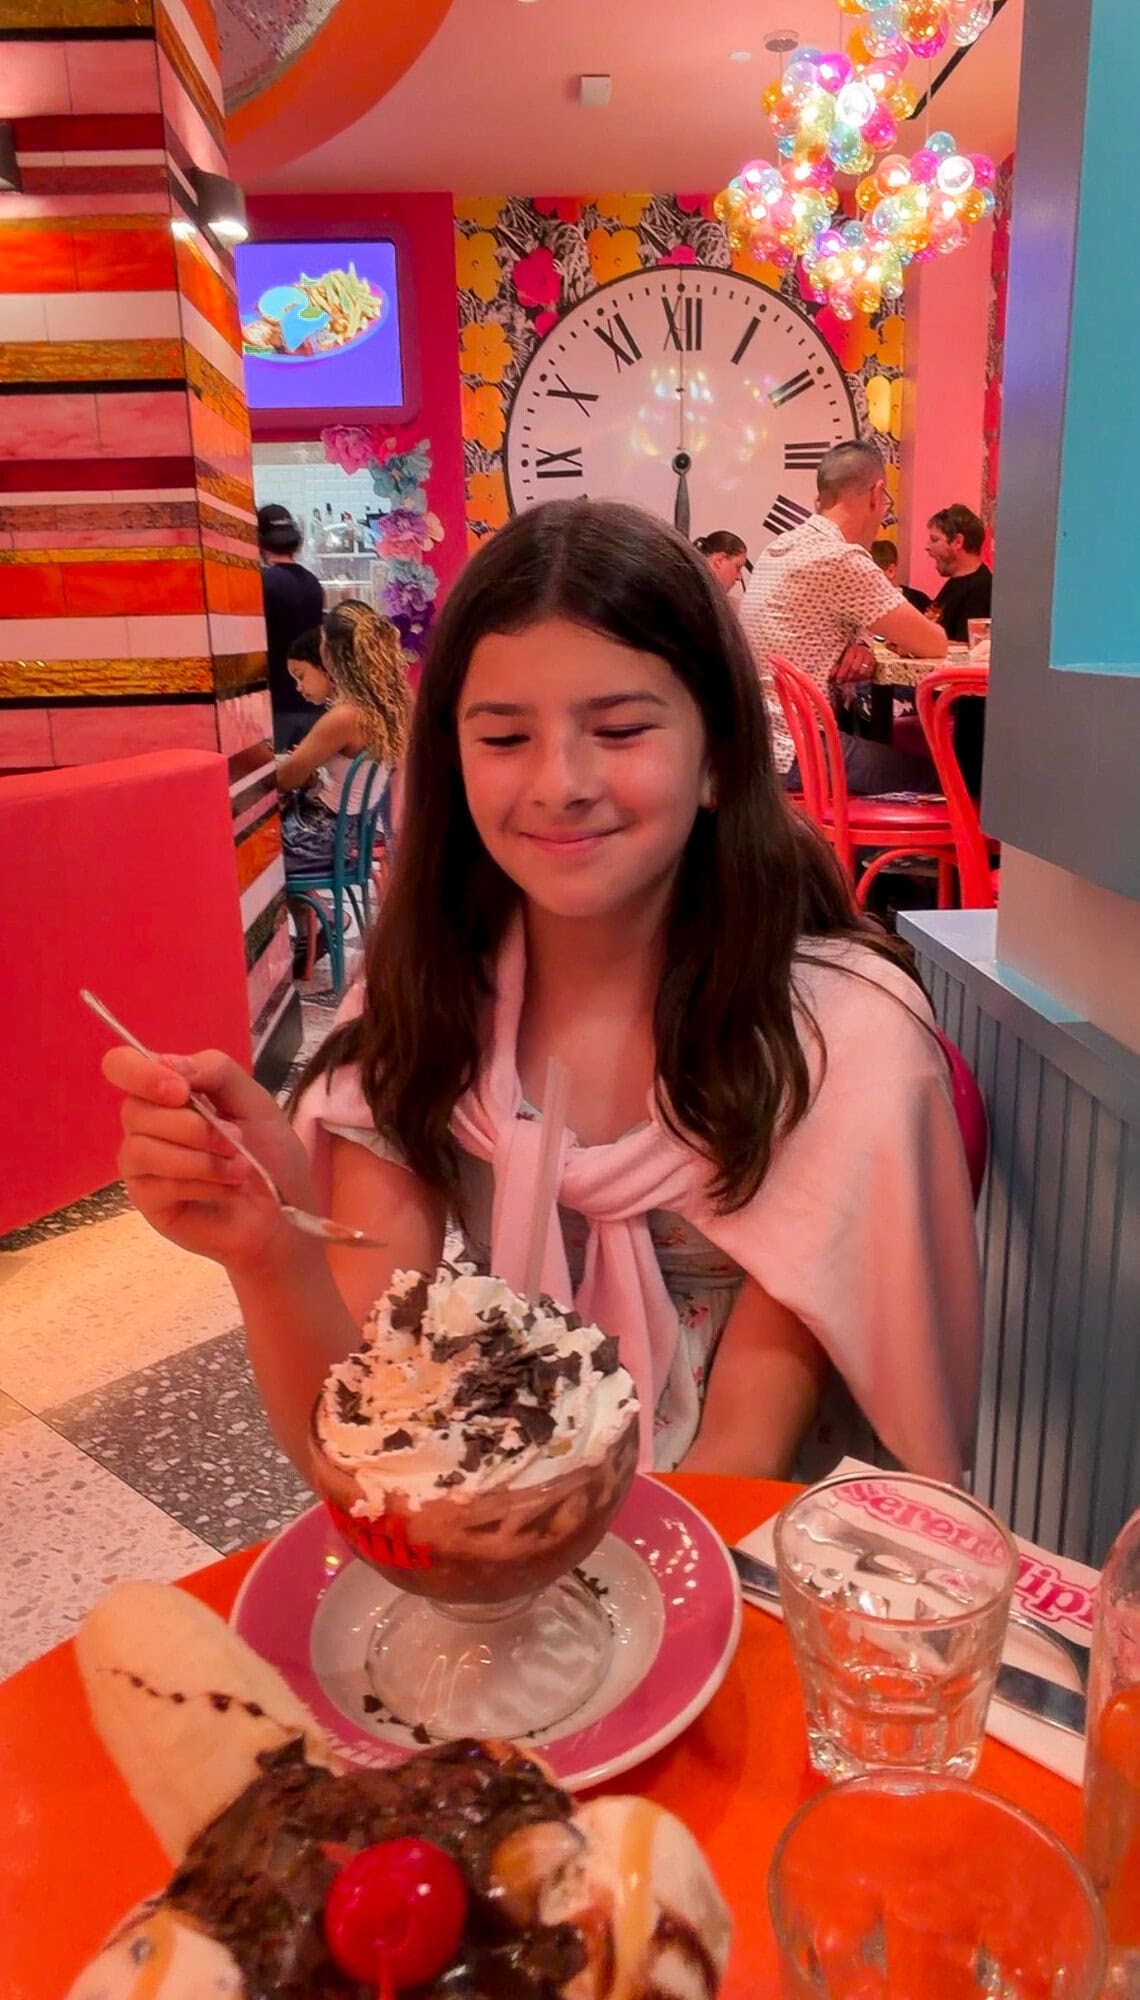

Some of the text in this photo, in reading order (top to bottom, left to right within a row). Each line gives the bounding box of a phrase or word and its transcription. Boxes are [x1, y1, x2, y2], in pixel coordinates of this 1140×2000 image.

[594, 313, 642, 373] XI
[662, 297, 702, 351] XII
[730, 316, 761, 365] I
[546, 374, 599, 418] X
[768, 369, 816, 408] II
[536, 447, 583, 479] IX
[784, 441, 831, 470] III
